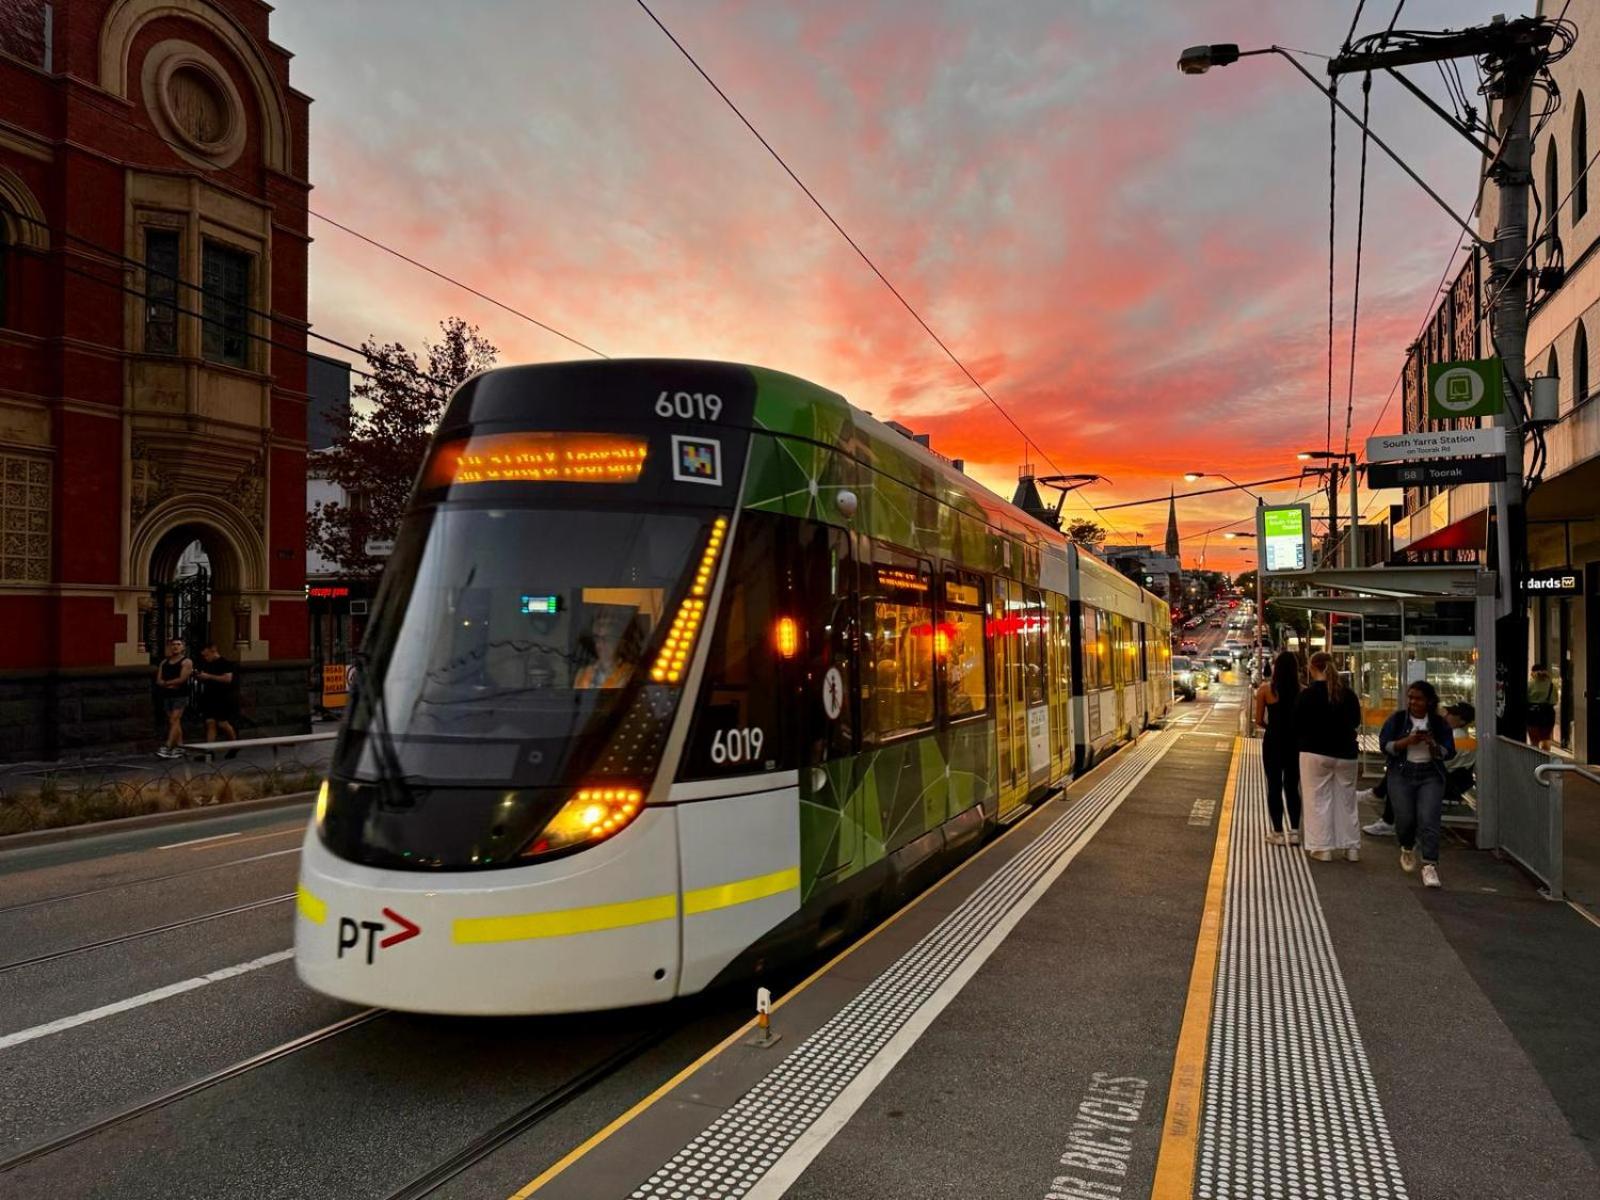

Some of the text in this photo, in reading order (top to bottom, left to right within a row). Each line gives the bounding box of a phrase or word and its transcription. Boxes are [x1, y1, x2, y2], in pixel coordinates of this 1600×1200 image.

[655, 391, 723, 421] 6019
[1383, 435, 1475, 448] South Yarra Station
[1404, 468, 1462, 479] 58 Toorak
[711, 727, 763, 763] 6019
[1060, 1072, 1148, 1176] BICYCLES
